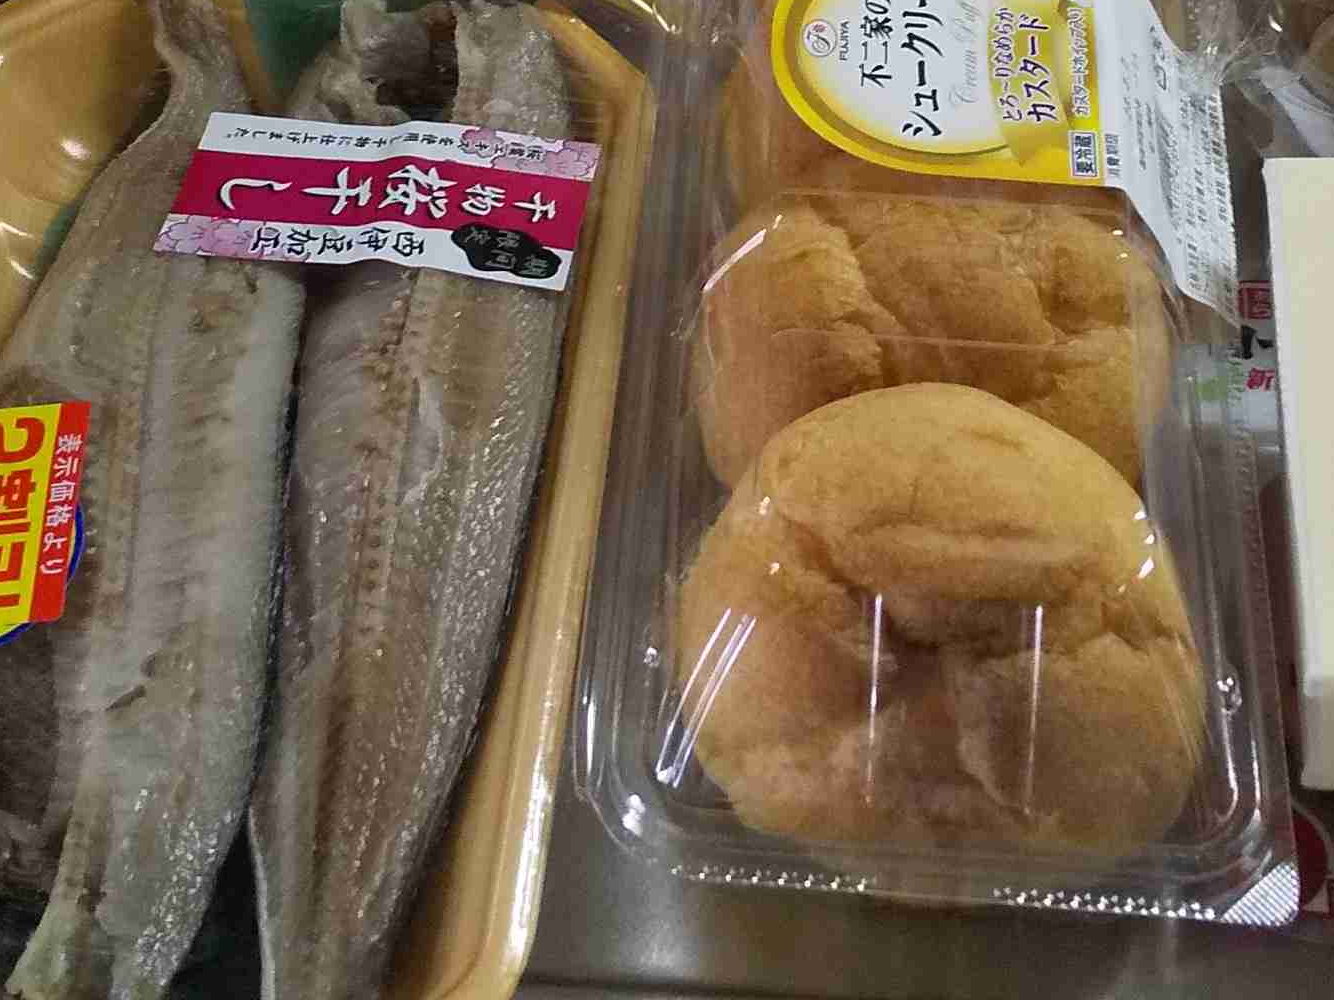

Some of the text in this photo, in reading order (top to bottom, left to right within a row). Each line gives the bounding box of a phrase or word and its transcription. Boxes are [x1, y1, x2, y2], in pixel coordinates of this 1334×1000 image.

[1017, 12, 1060, 123] カスタード
[40, 433, 83, 576] 表示価格より
